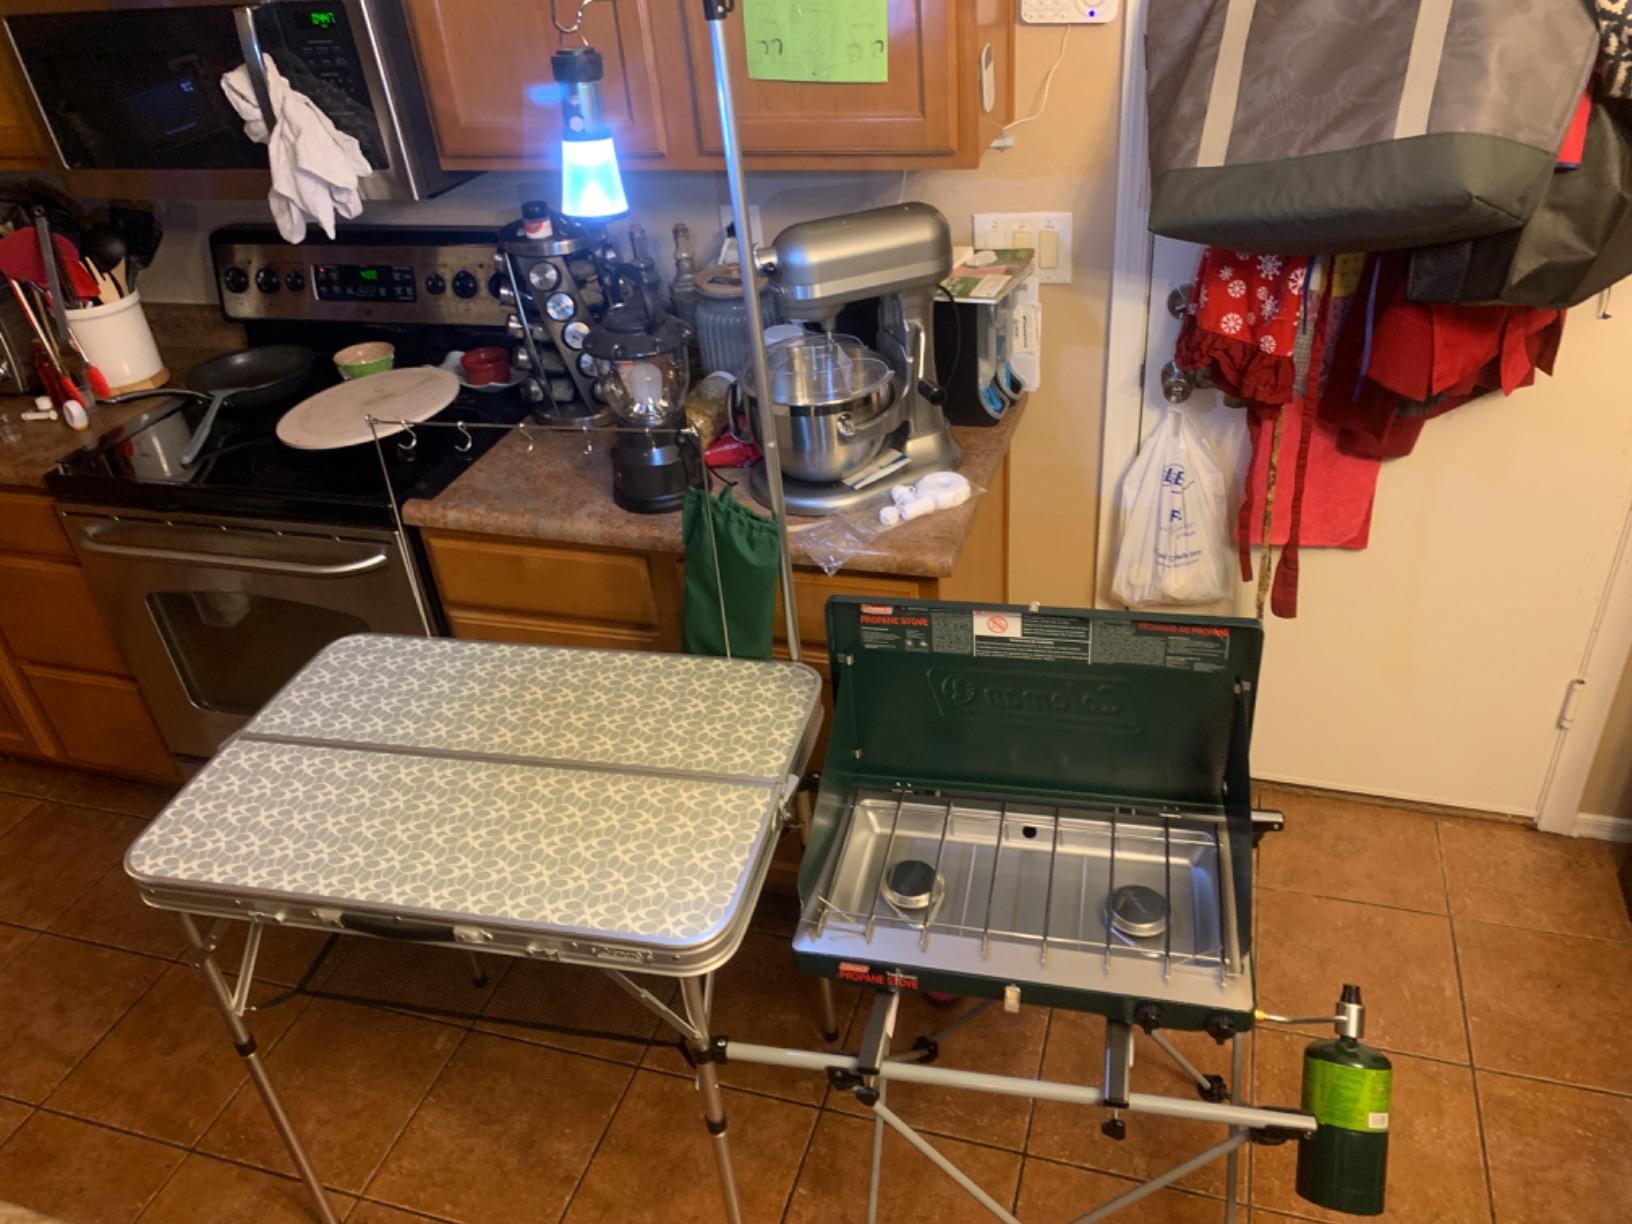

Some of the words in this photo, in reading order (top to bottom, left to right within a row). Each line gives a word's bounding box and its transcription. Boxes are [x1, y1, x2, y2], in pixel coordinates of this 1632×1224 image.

[860, 615, 898, 625] PROPANE
[900, 617, 929, 627] STOVE
[838, 970, 884, 984] PROPANE
[887, 976, 918, 989] STOVE
